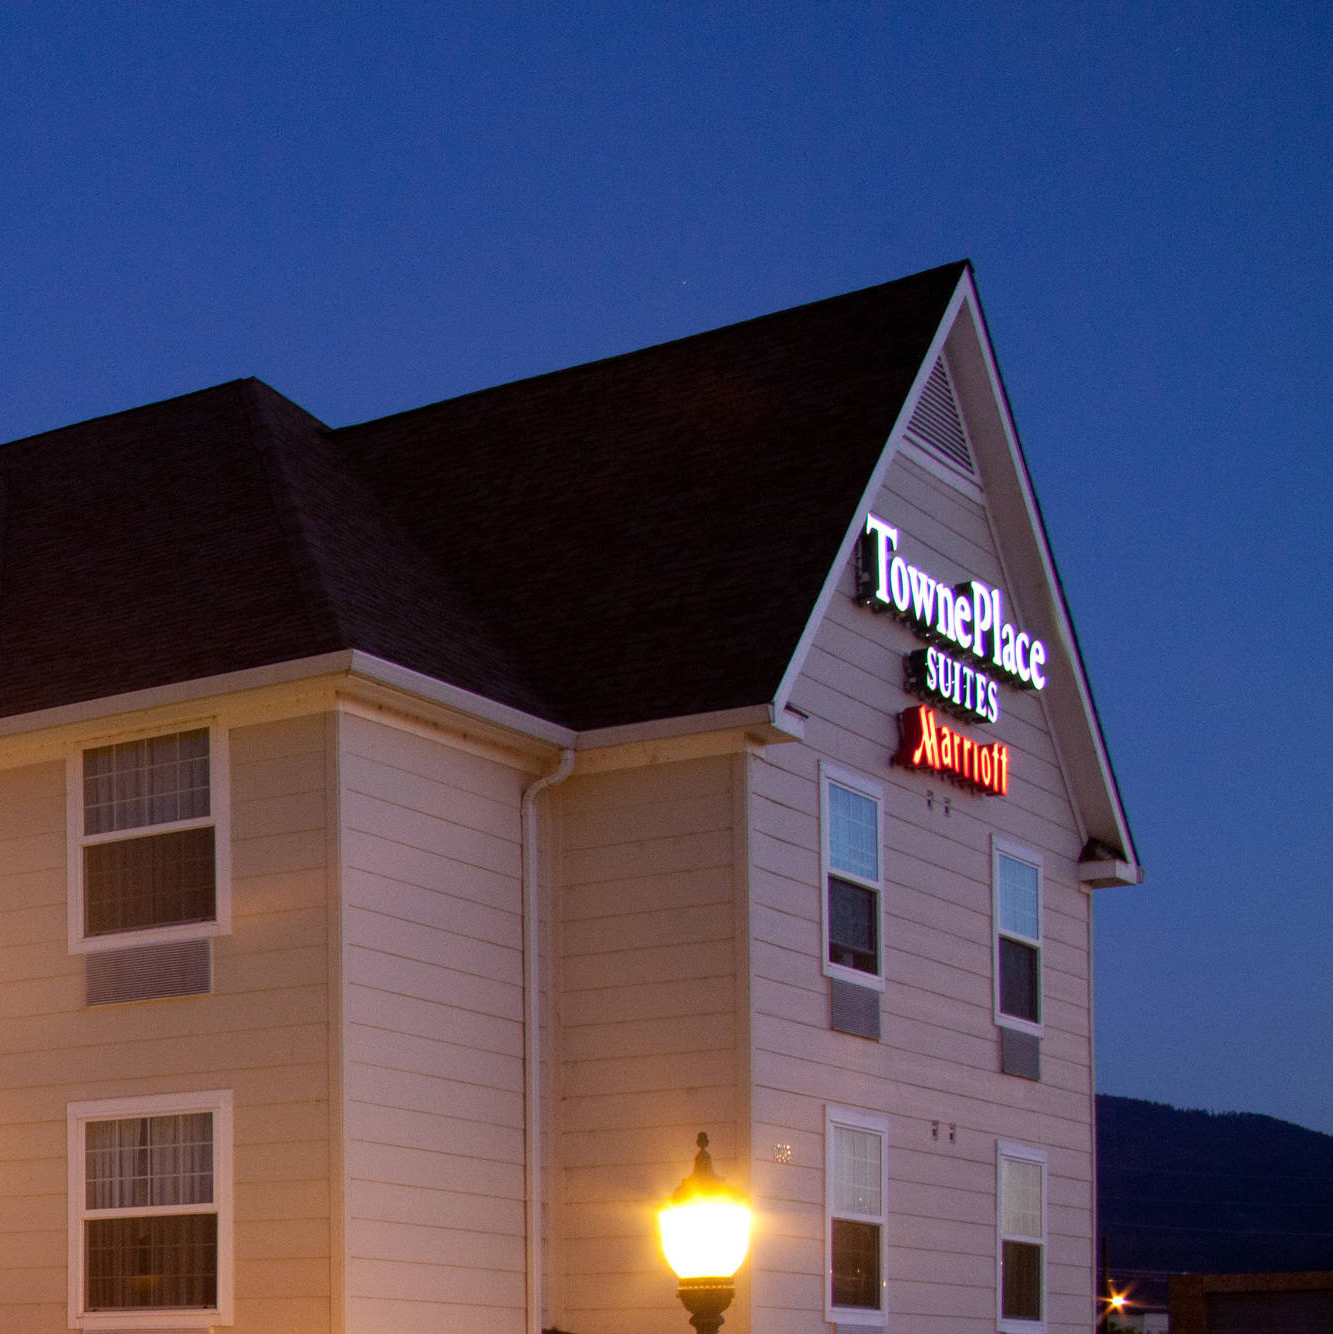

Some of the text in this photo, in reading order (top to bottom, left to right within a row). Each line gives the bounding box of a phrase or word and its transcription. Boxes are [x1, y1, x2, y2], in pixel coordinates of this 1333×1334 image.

[866, 513, 1047, 691] TownePlace
[926, 645, 1000, 724] SUITES
[912, 704, 1010, 796] Marriott
